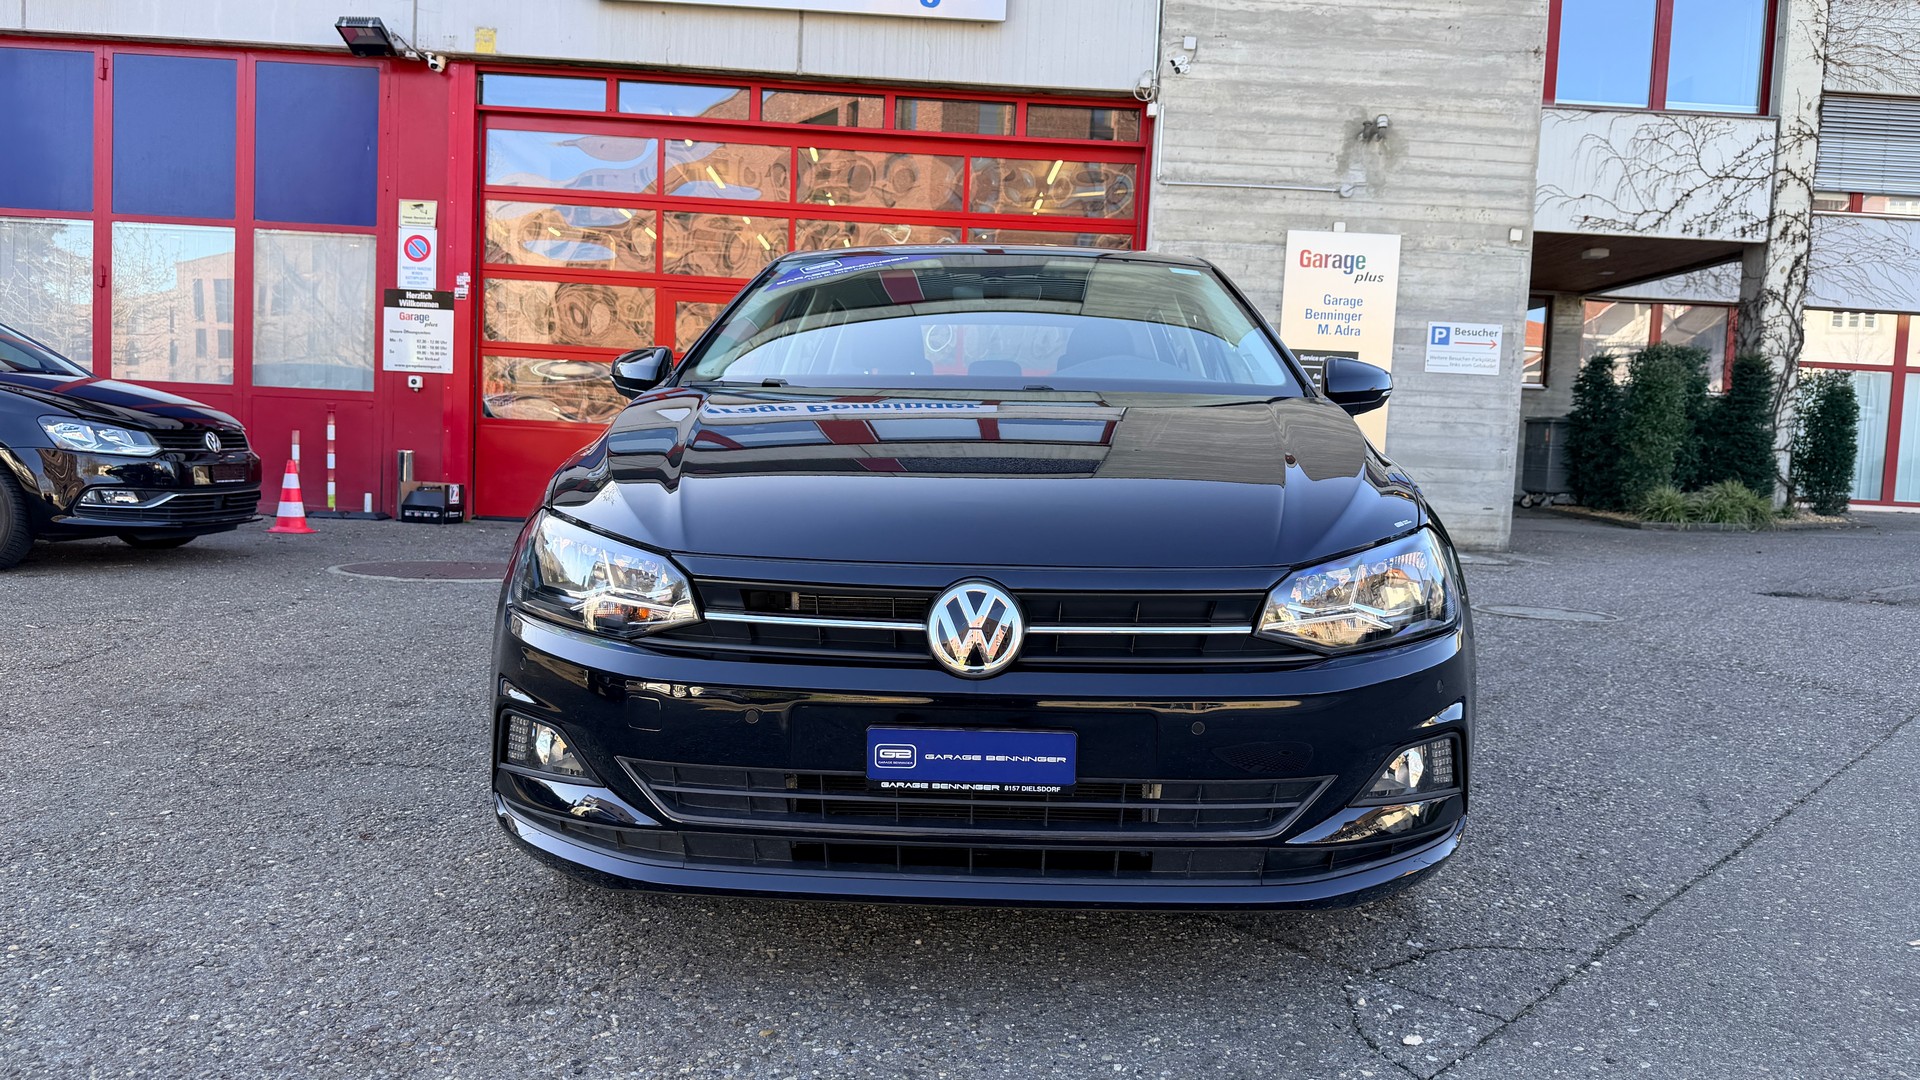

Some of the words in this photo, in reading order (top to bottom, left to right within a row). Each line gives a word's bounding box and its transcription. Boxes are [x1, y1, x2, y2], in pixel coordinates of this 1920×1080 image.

[1299, 249, 1366, 274] Garage
[1354, 271, 1384, 283] plus
[406, 291, 433, 300] Herzlich
[1323, 294, 1363, 308] Garage
[398, 299, 440, 308] Willkommen
[399, 312, 430, 323] Garage
[1305, 308, 1362, 323] Benninger
[1317, 324, 1332, 335] M.
[1334, 325, 1361, 336] Adra
[1434, 328, 1447, 343] P
[1454, 327, 1499, 337] Besucher
[985, 755, 1067, 763] BENNINGER
[880, 781, 928, 789] GARAGE
[931, 783, 1000, 791] BENNINGER
